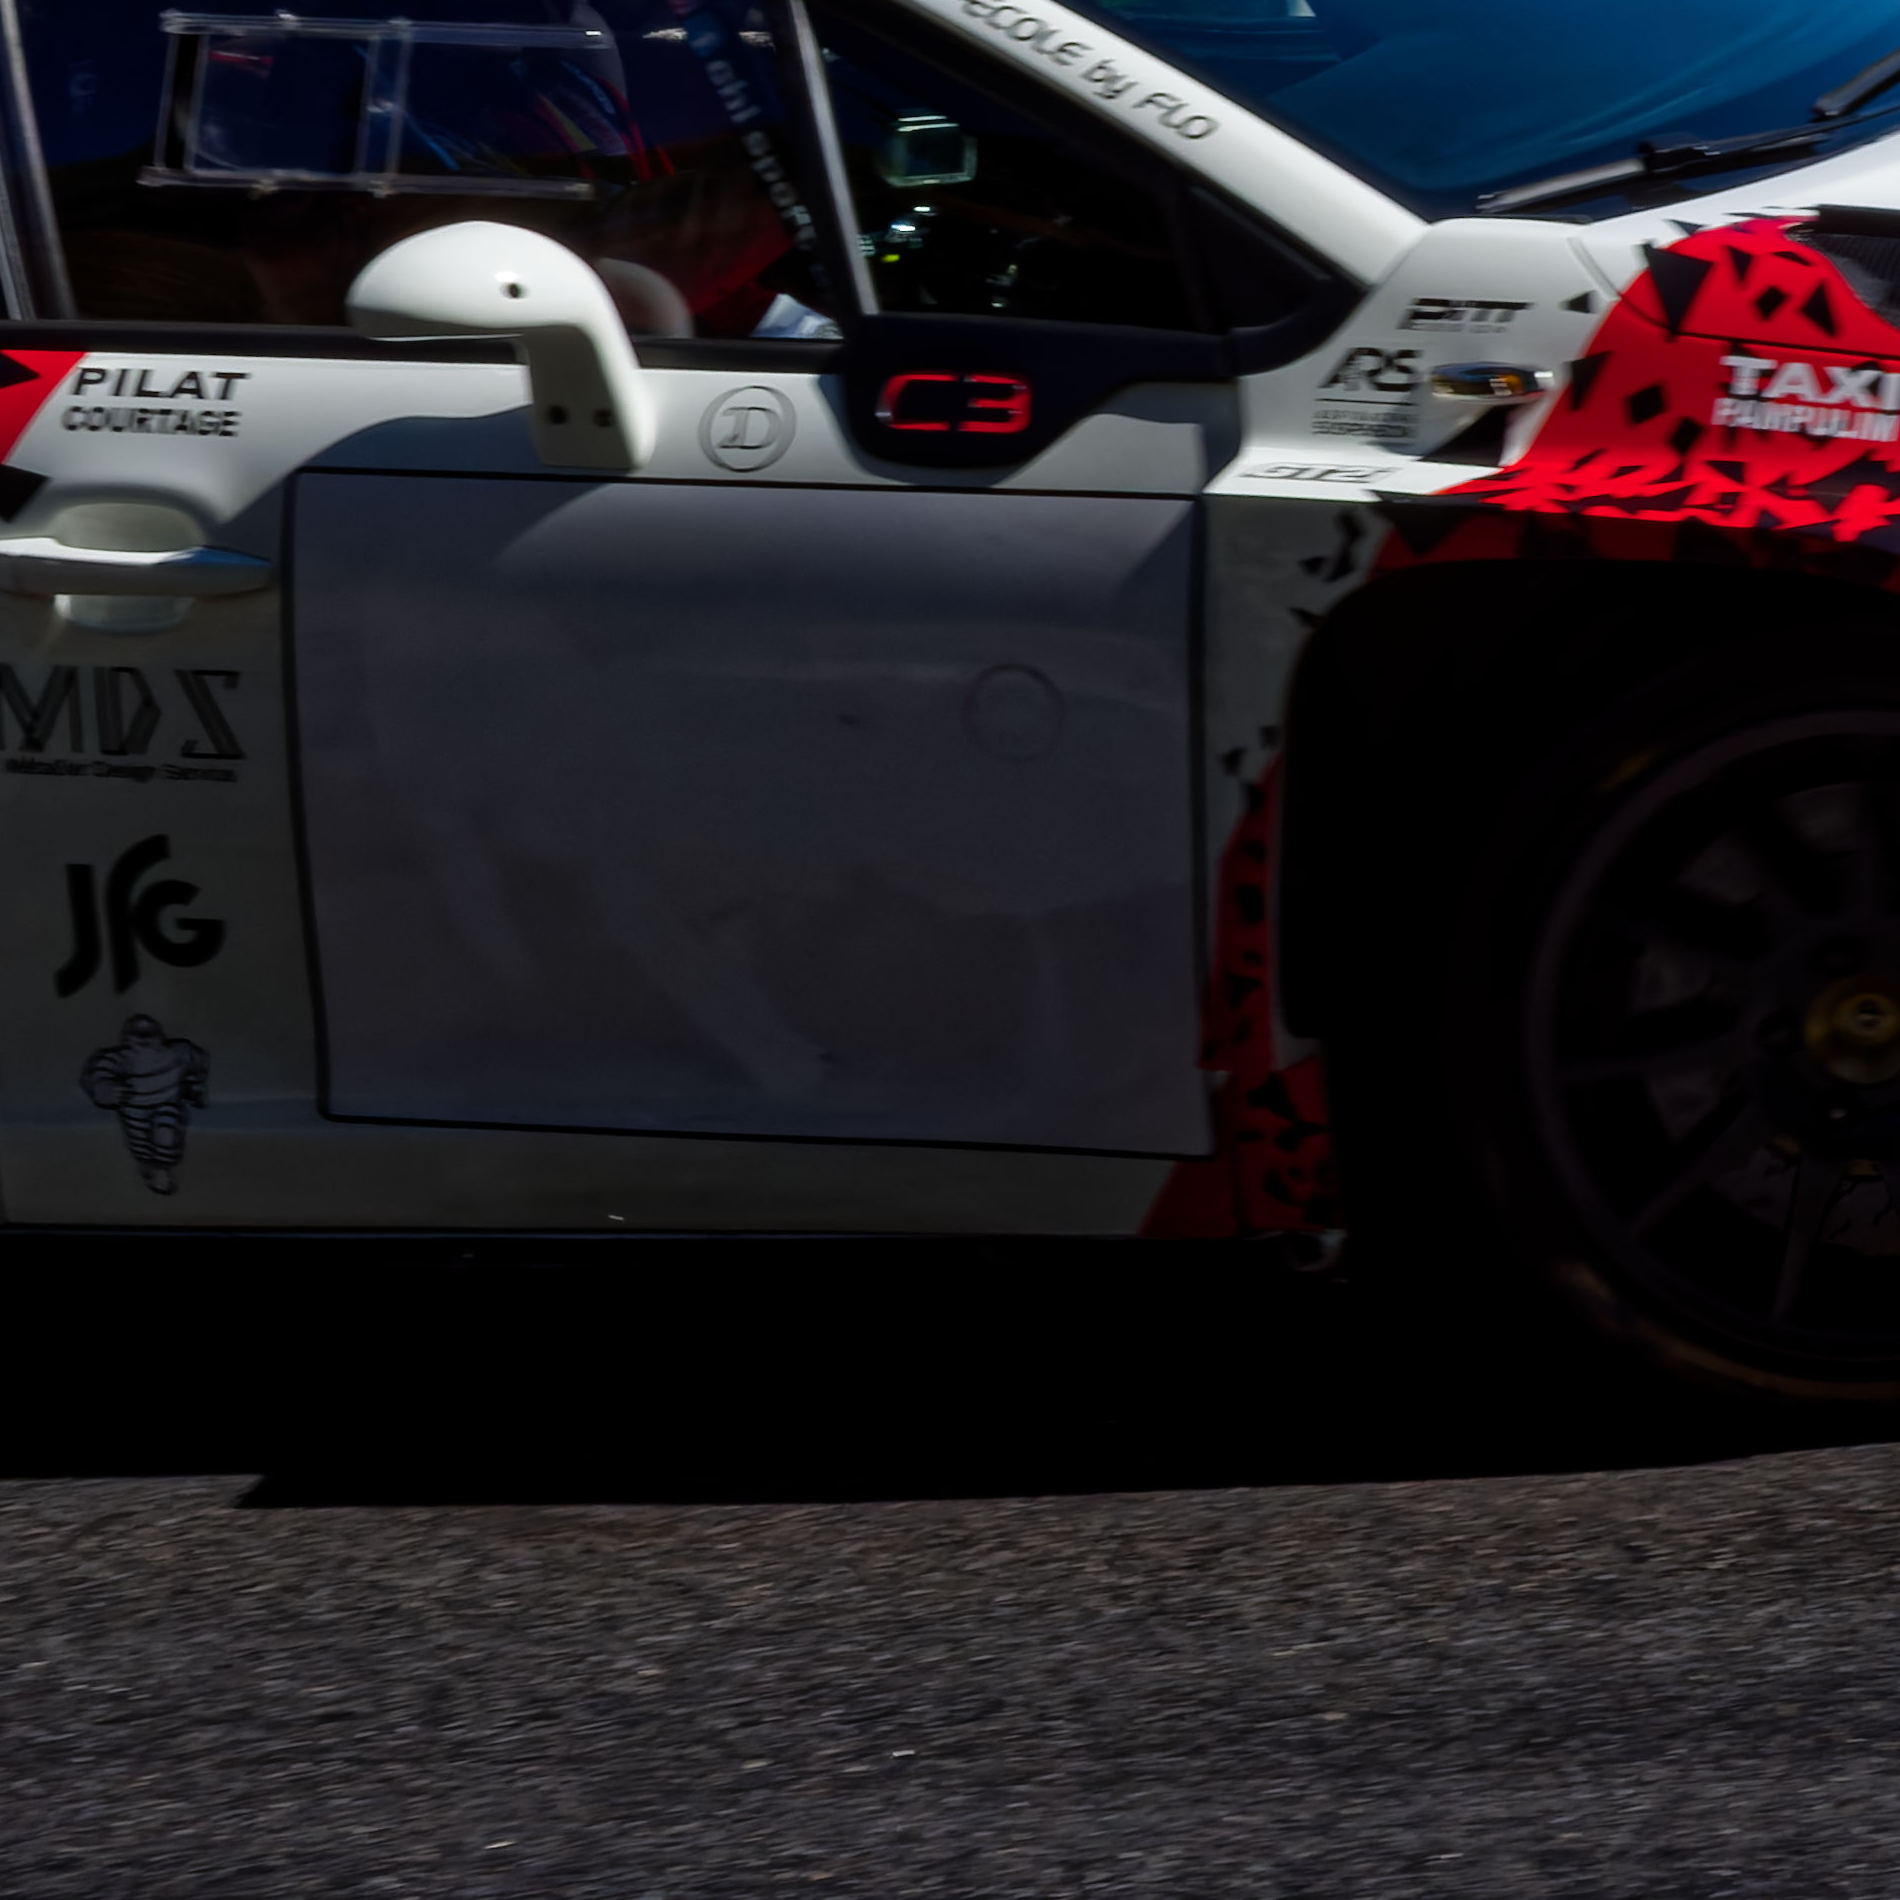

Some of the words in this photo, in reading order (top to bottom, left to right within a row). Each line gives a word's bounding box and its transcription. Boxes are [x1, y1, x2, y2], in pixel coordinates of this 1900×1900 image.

[1082, 58, 1139, 101] by
[1131, 91, 1221, 141] FLO
[69, 366, 251, 401] PILAT
[873, 370, 1033, 436] C3
[61, 404, 242, 438] COURTAGE
